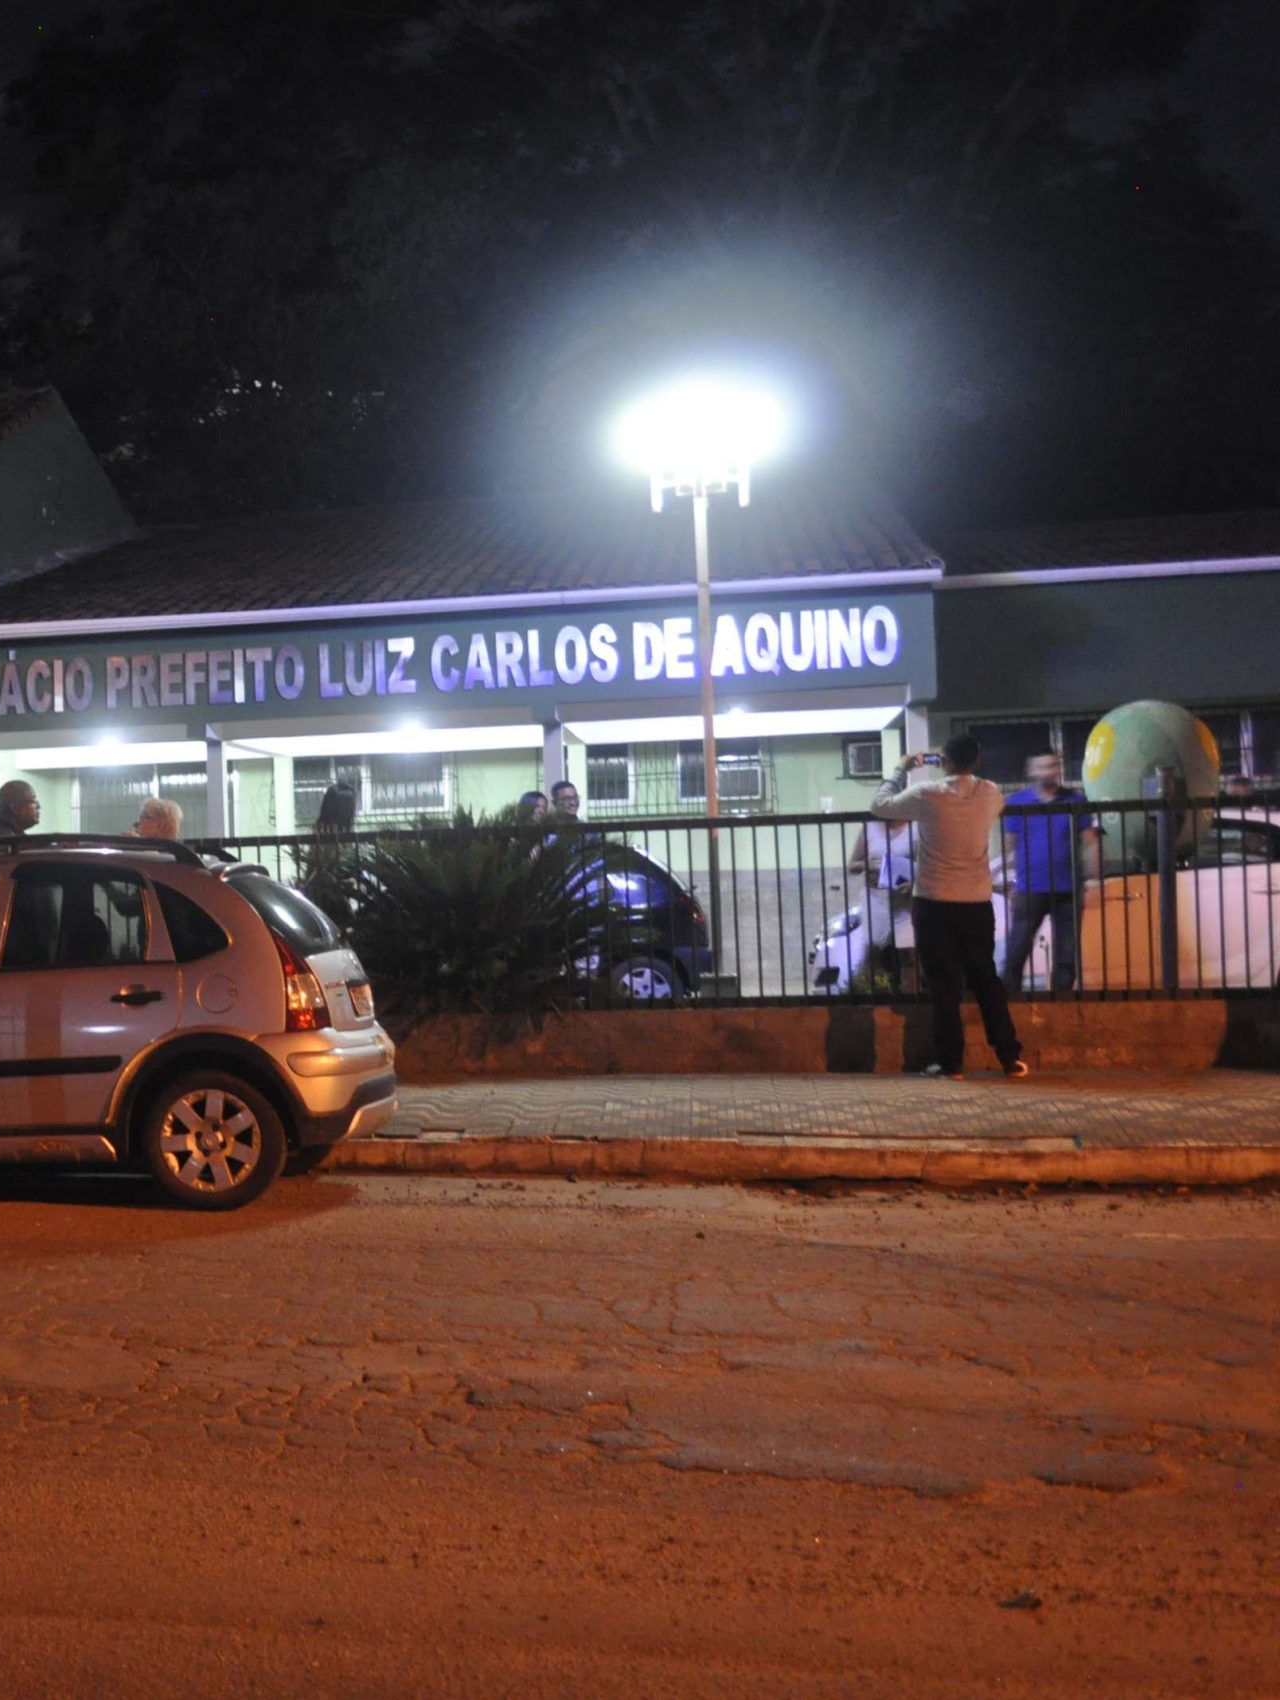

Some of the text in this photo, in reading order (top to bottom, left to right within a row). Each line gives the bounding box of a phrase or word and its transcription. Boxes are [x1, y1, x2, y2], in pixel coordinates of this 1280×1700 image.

[106, 645, 306, 709] PREFEITO
[320, 637, 417, 699] LUIZ
[430, 622, 619, 693] CARLOS
[632, 617, 695, 680] DE
[710, 604, 900, 676] AQUINO
